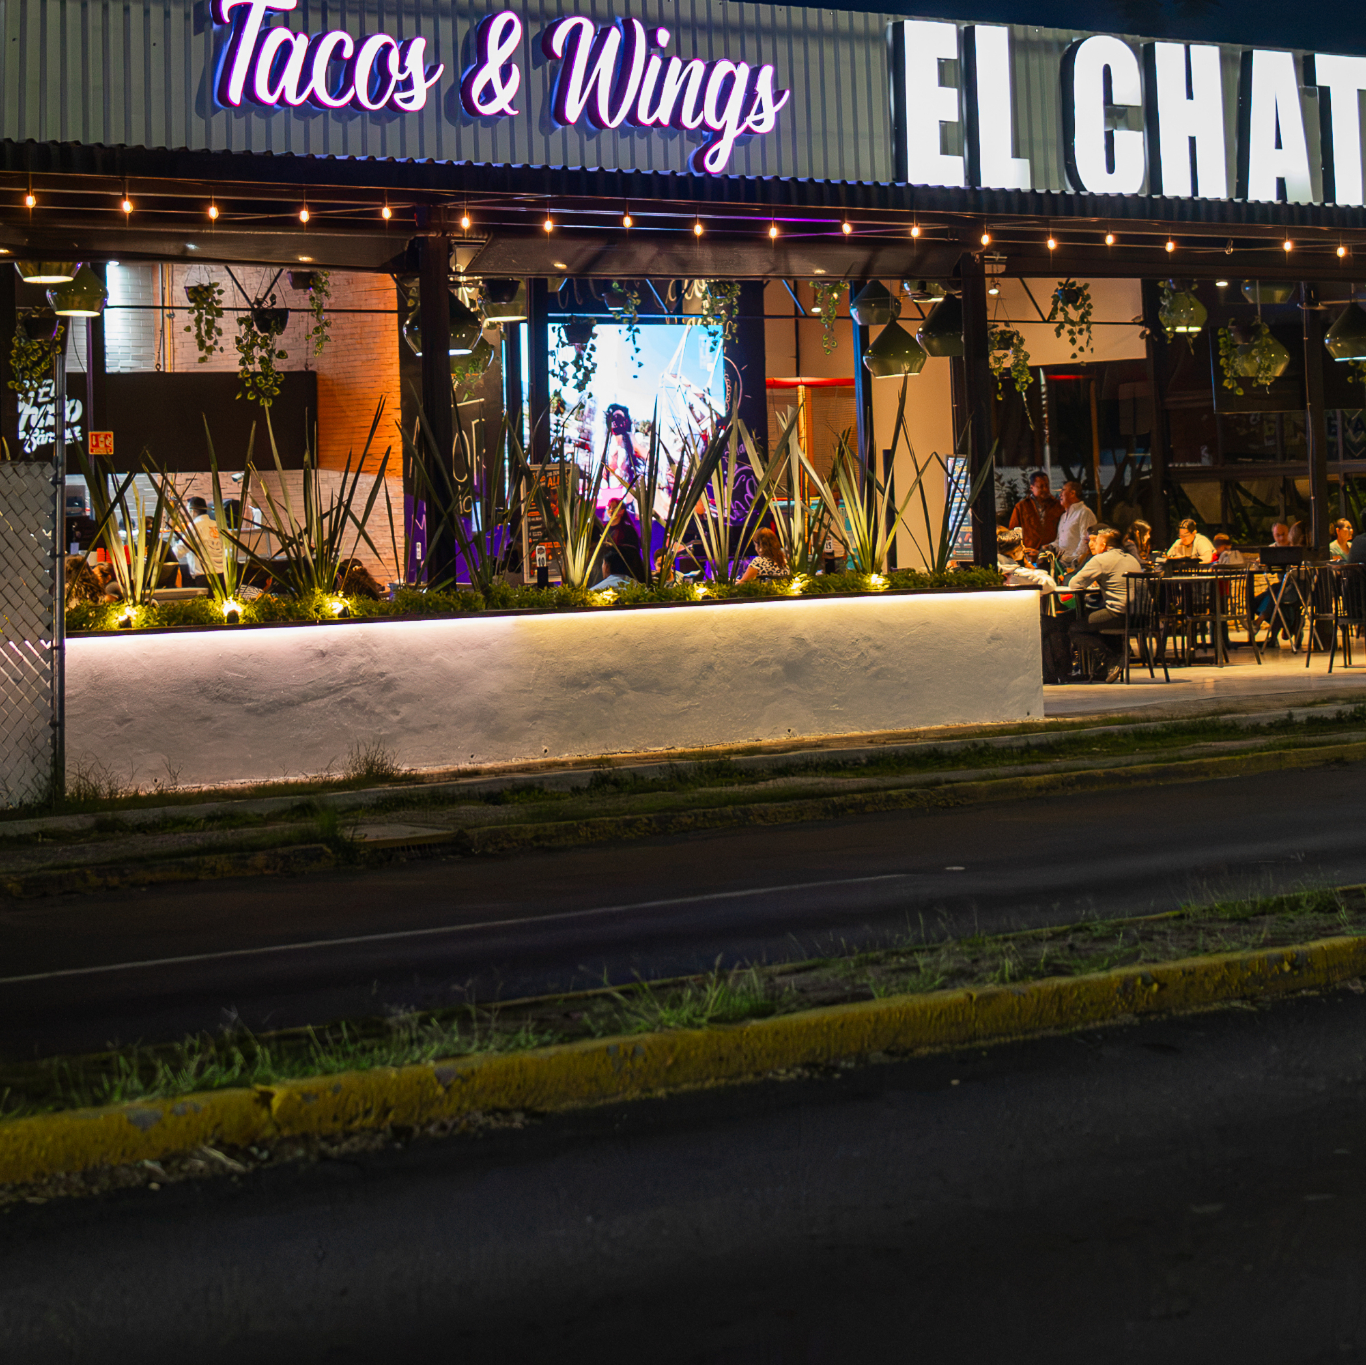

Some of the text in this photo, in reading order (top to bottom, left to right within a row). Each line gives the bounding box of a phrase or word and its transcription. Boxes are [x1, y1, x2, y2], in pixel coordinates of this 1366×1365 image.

[461, 10, 522, 117] &
[543, 16, 790, 174] Wings
[897, 19, 1030, 190] EL
